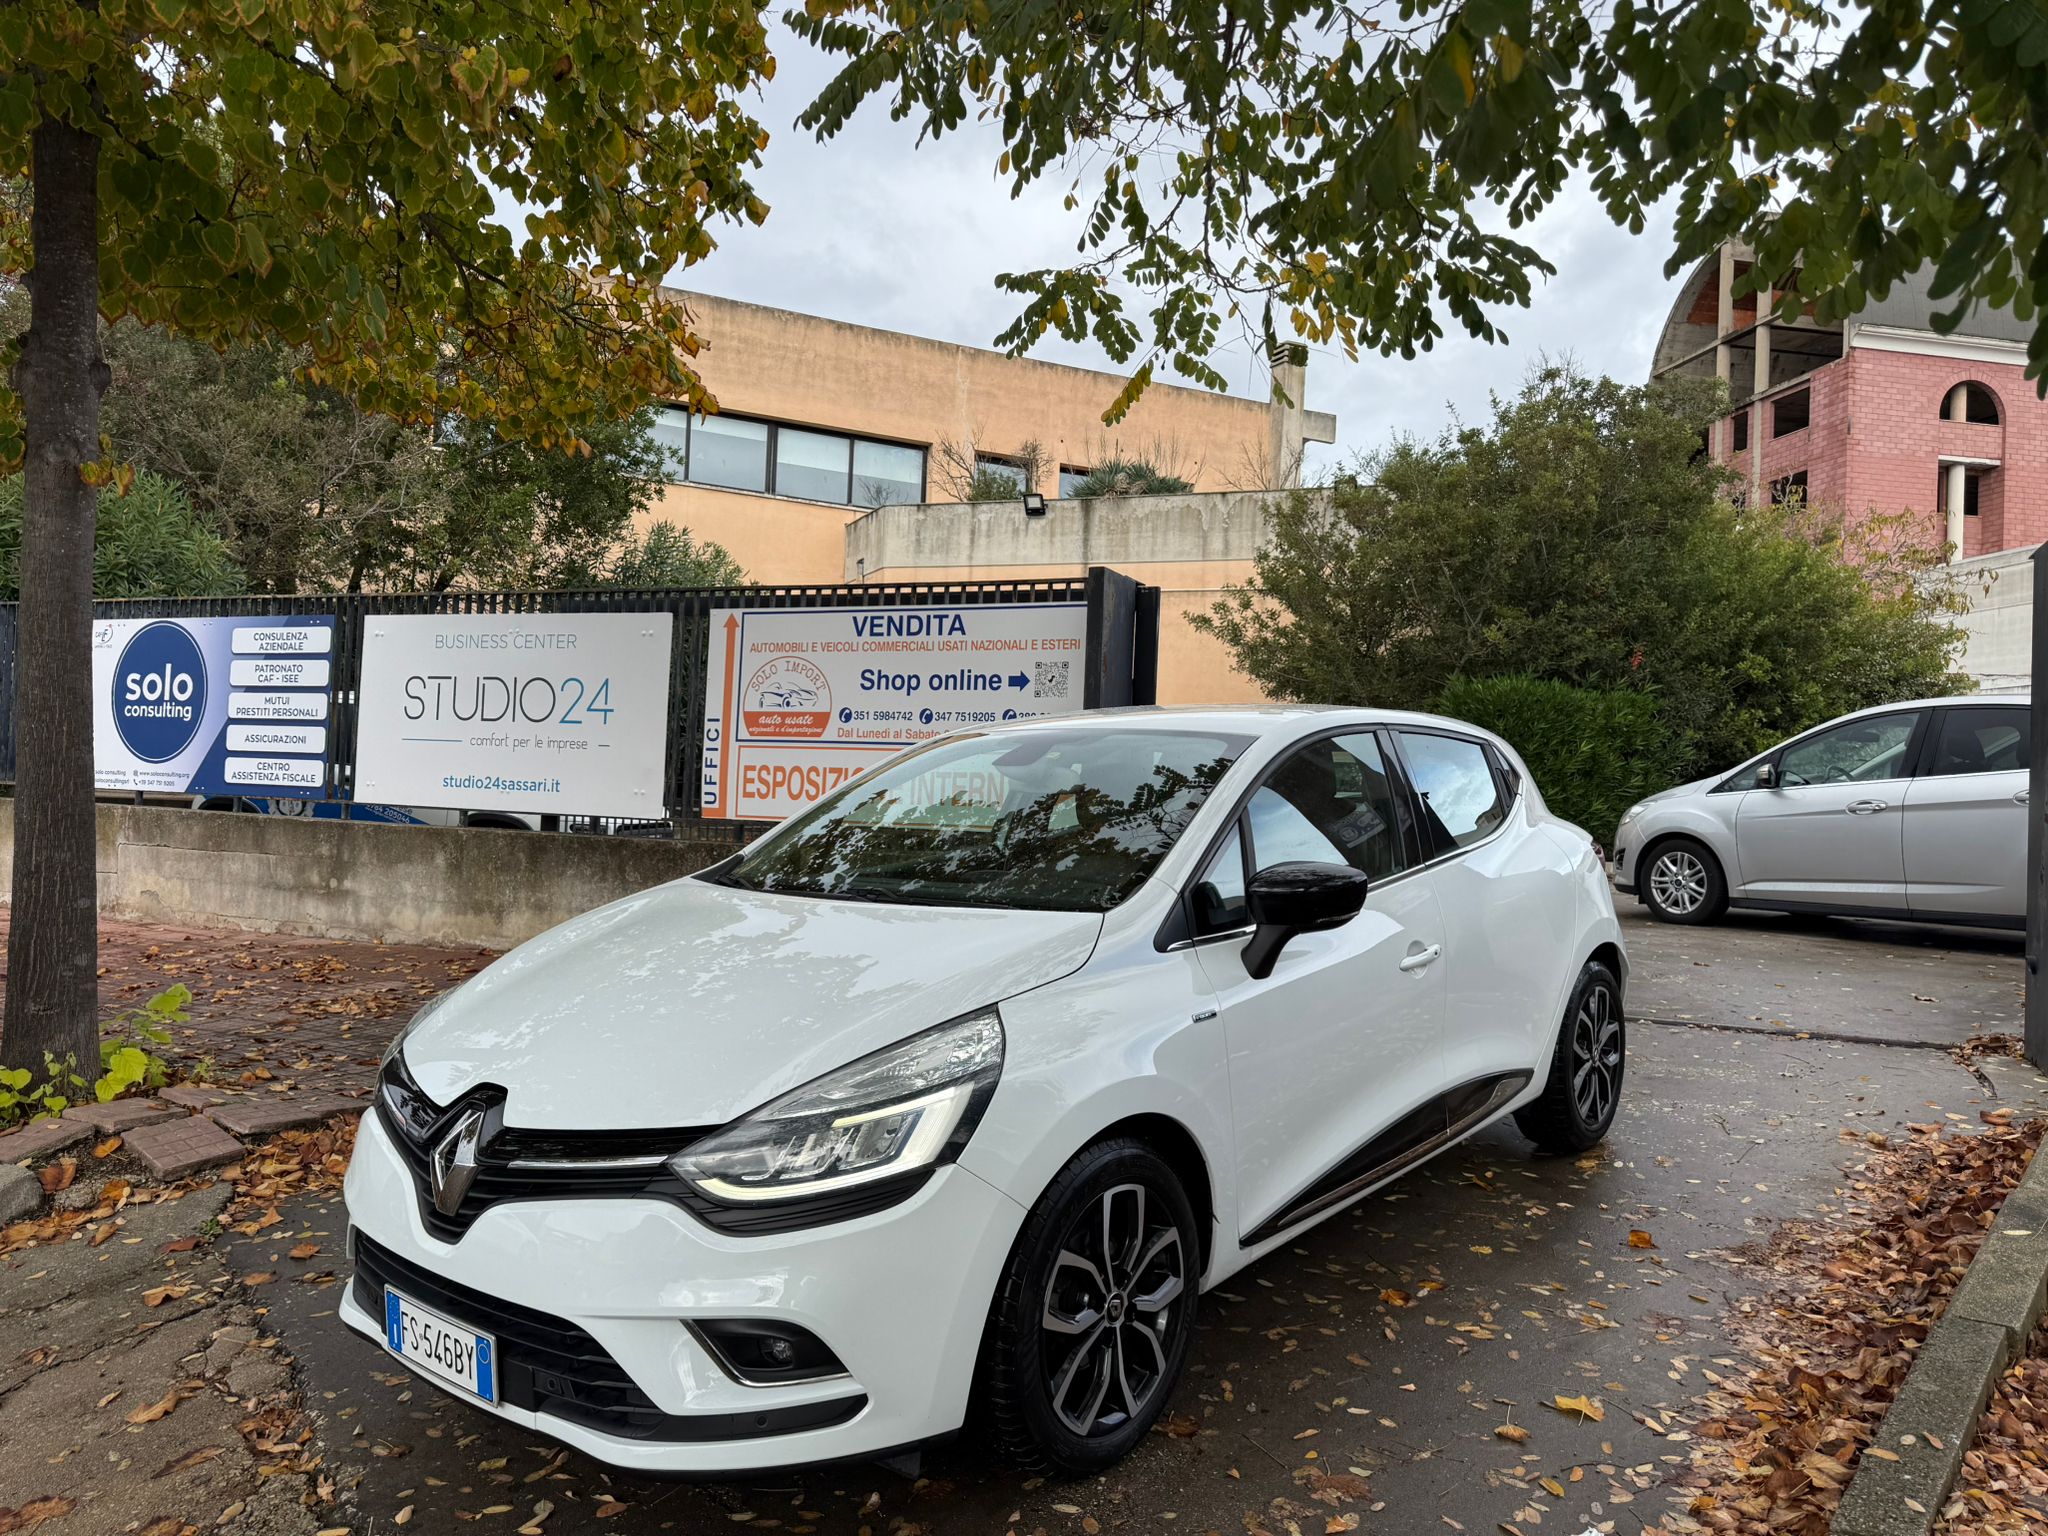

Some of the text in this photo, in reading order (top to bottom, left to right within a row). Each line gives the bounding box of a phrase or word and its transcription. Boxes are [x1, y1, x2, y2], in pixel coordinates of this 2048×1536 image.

[852, 614, 966, 638] VENDITA
[253, 632, 308, 641] CONSULENZA
[435, 633, 577, 650] BUSINESS CENTER
[258, 642, 304, 651] AZIENDALE
[750, 638, 1081, 653] AUTOMOBILI E VEICOLI COMMERCIALI USATI NAZIONALI E ESTERI
[254, 664, 303, 673] PATRONATO
[125, 663, 194, 701] solo
[257, 674, 274, 683] CAF
[281, 674, 299, 683] ISEE
[751, 660, 827, 692] SOLO IMPORT
[859, 668, 1002, 696] Shop online
[264, 696, 290, 705] MUTUI
[404, 675, 614, 725] STUDIO24
[124, 702, 192, 721] consulting
[235, 707, 318, 717] PRESTITI PERSONALI
[853, 710, 913, 722] 351 5984742
[934, 711, 996, 722] 347 7519205
[758, 714, 814, 725] auto usate
[244, 734, 307, 744] ASSICURAZIONI
[837, 727, 854, 738] Dal
[893, 728, 902, 739] al
[470, 732, 588, 754] comfort per le imprese
[257, 762, 290, 772] CENTRO
[704, 716, 721, 806] UFFICI
[231, 772, 316, 783] ASSISTENZA FISCALE
[442, 775, 561, 793] studio24sassari.it
